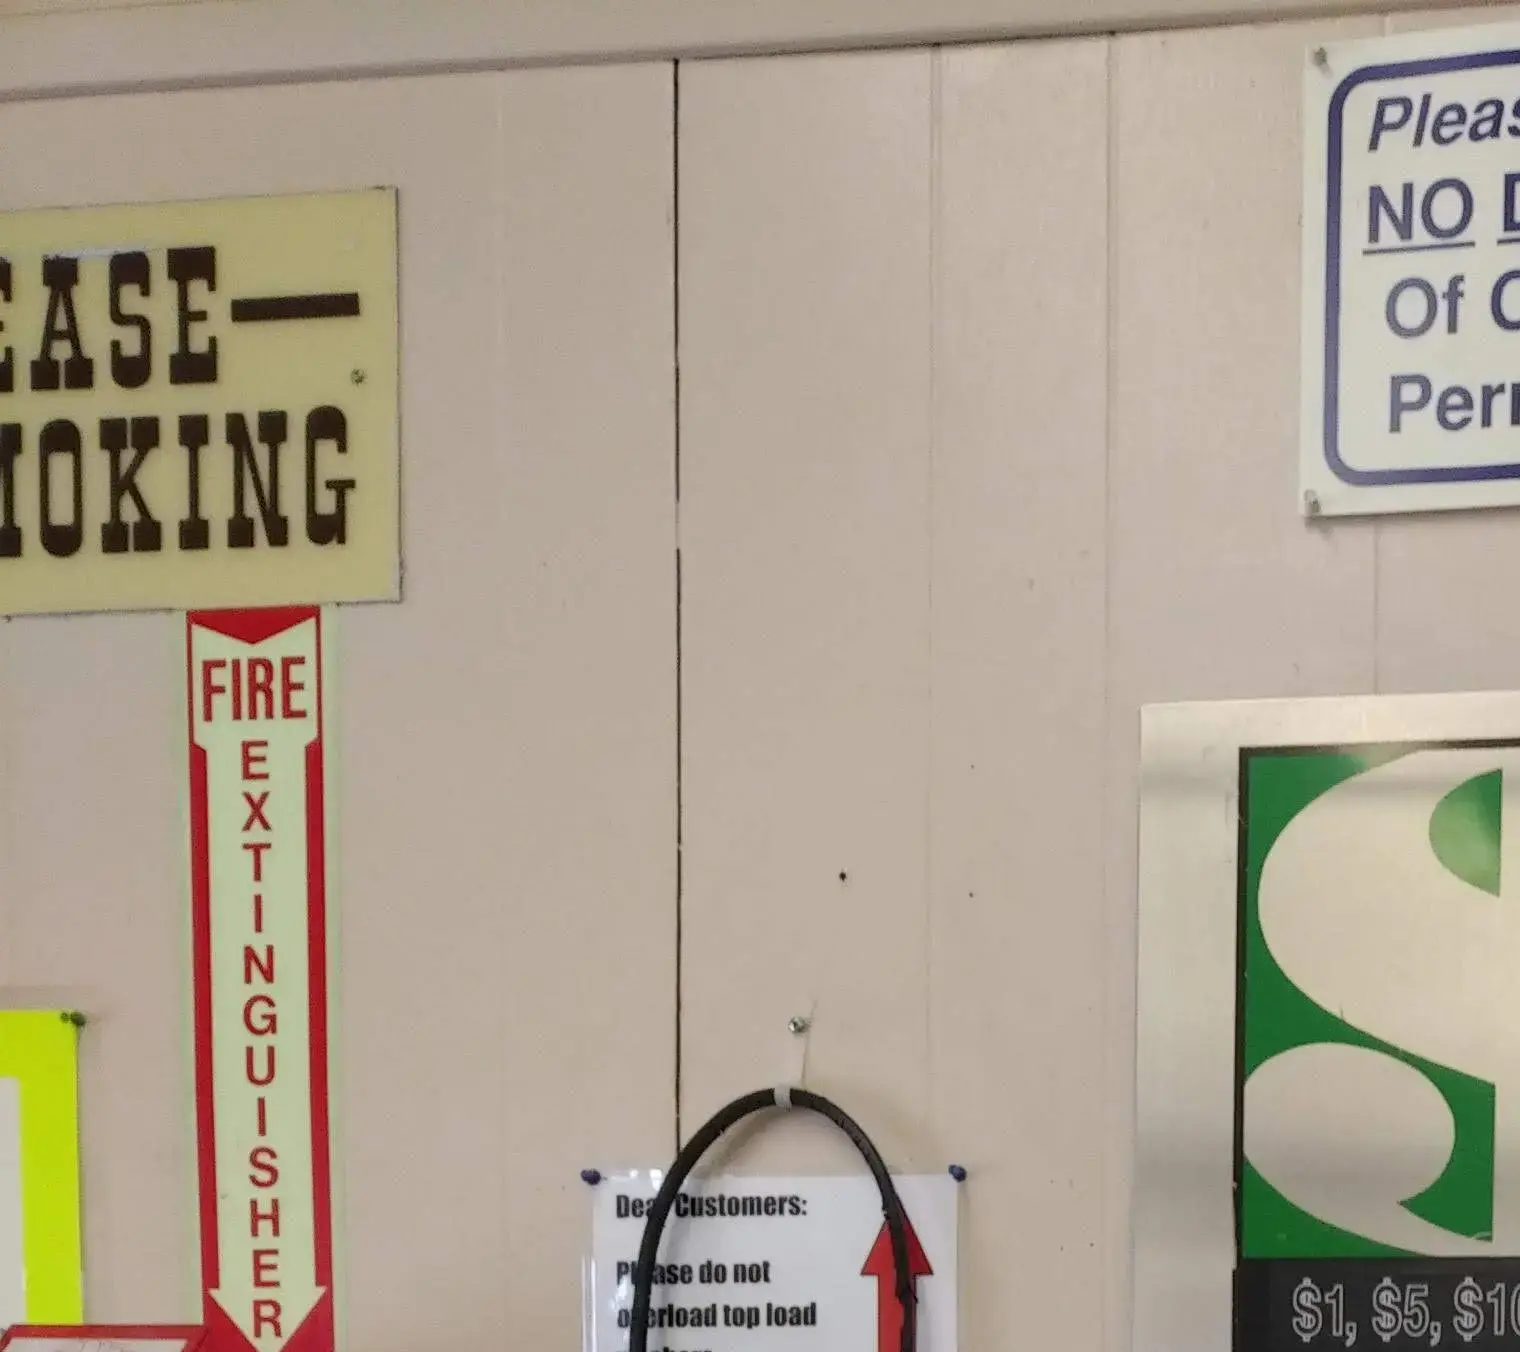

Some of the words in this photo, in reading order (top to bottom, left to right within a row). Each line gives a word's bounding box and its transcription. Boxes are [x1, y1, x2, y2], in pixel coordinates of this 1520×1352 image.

[1368, 177, 1474, 244] NO
[1385, 274, 1465, 338] Of
[202, 656, 309, 724] FIRE
[240, 738, 284, 1342] EXTINGUISHER
[616, 1194, 663, 1218] Dea
[674, 1193, 808, 1218] Customers:
[616, 1260, 693, 1285] Plase
[699, 1260, 728, 1284] do
[733, 1260, 771, 1284] not
[617, 1302, 717, 1328] oerload
[723, 1304, 760, 1329] top
[766, 1302, 817, 1326] load
[1291, 1276, 1357, 1347] $1,
[1372, 1276, 1441, 1346] $5,
